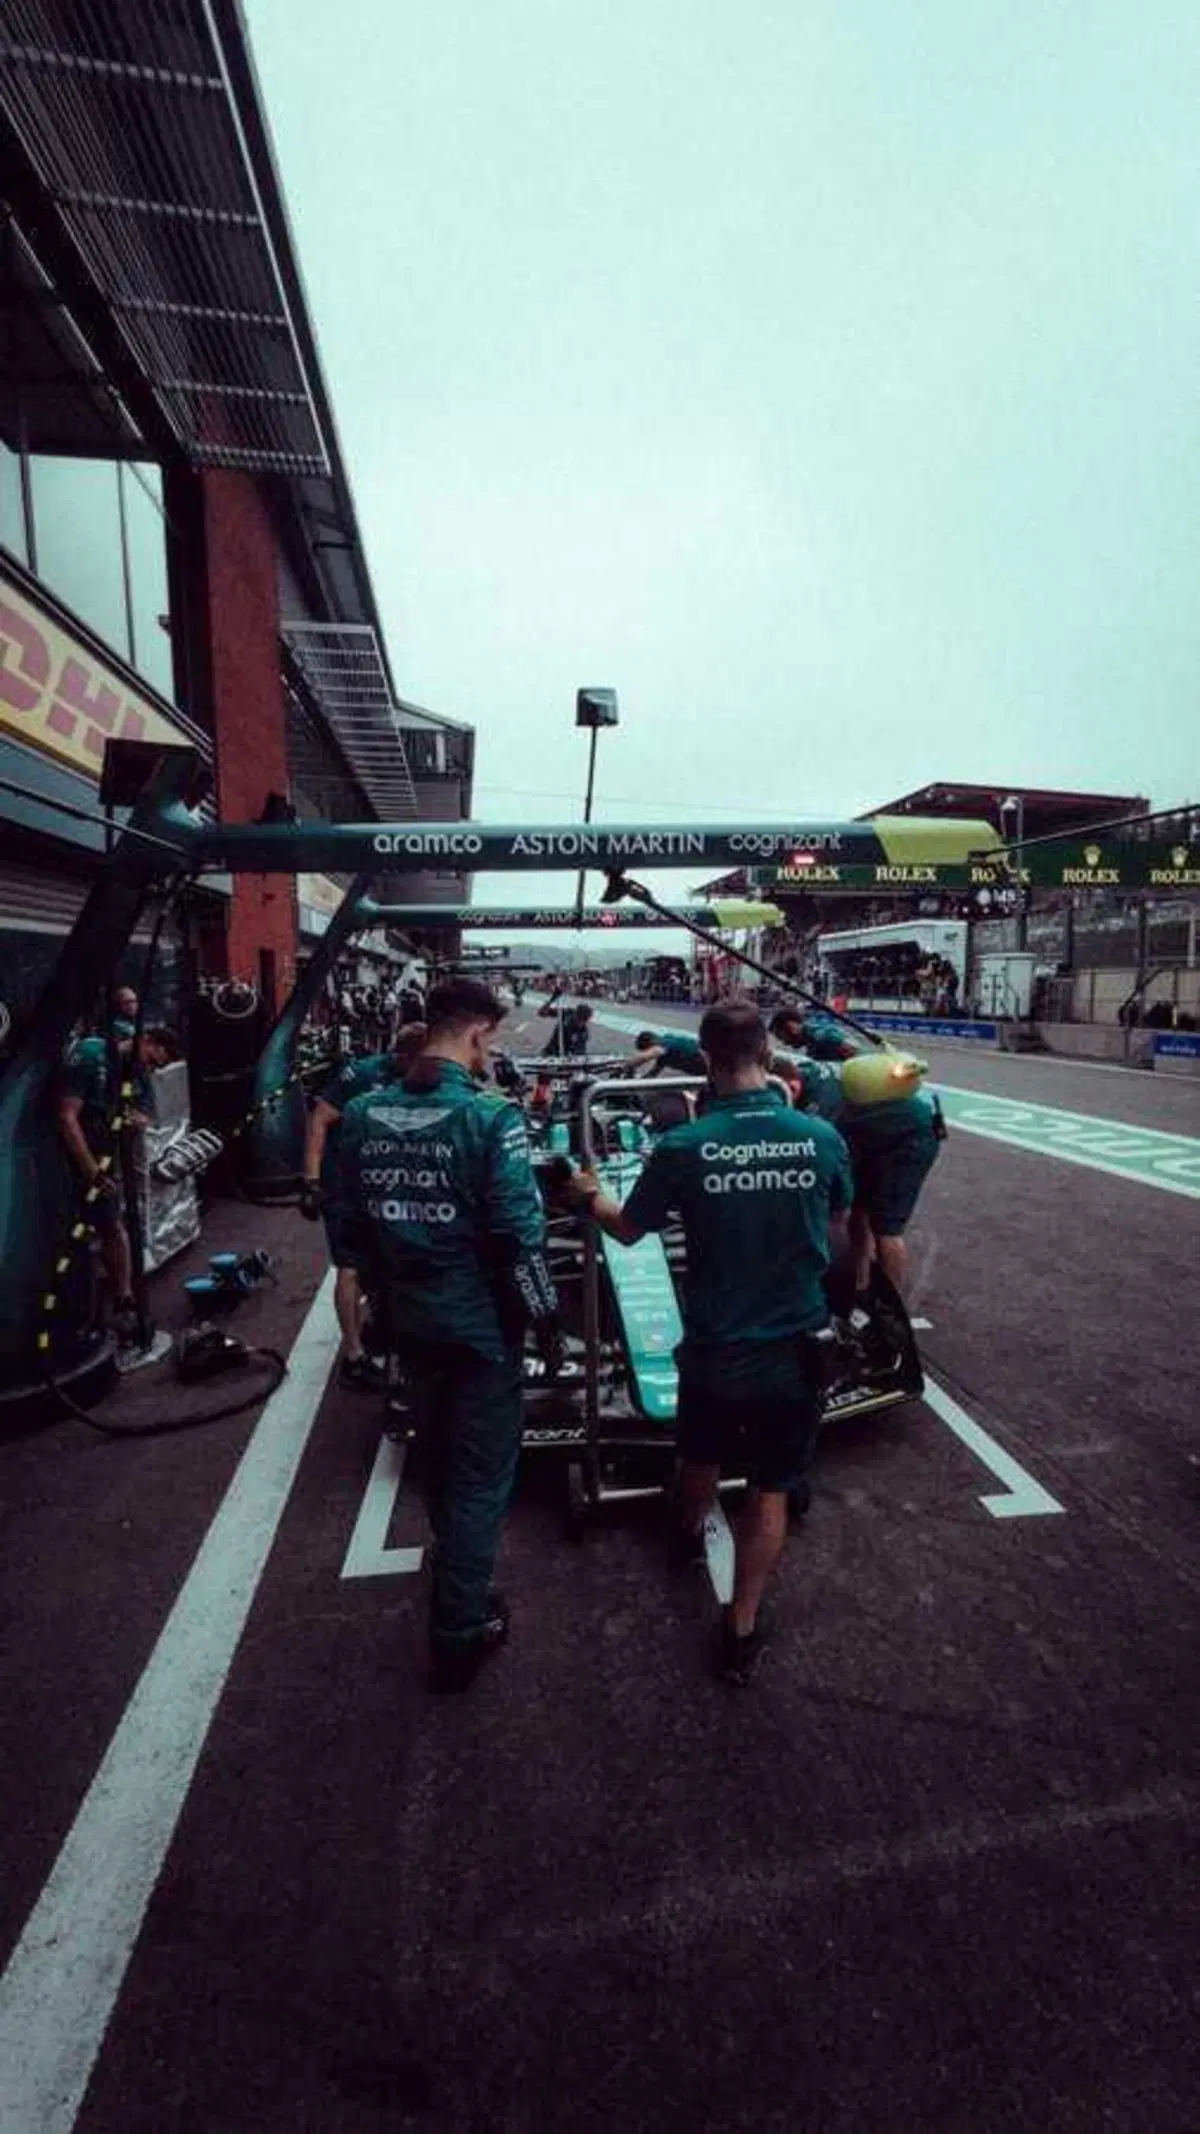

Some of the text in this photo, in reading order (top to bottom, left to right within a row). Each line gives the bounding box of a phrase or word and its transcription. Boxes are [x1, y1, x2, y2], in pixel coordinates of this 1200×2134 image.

[373, 830, 842, 857] aramco ASTON MARTIN cognizant
[776, 864, 840, 881] ROLEX
[875, 866, 937, 882] ROLEX
[971, 865, 1030, 883] ROX
[1062, 867, 1120, 884] ROLEX
[701, 1138, 817, 1165] Cognizant
[703, 1168, 817, 1194] aramco
[367, 1199, 457, 1223] aamco
